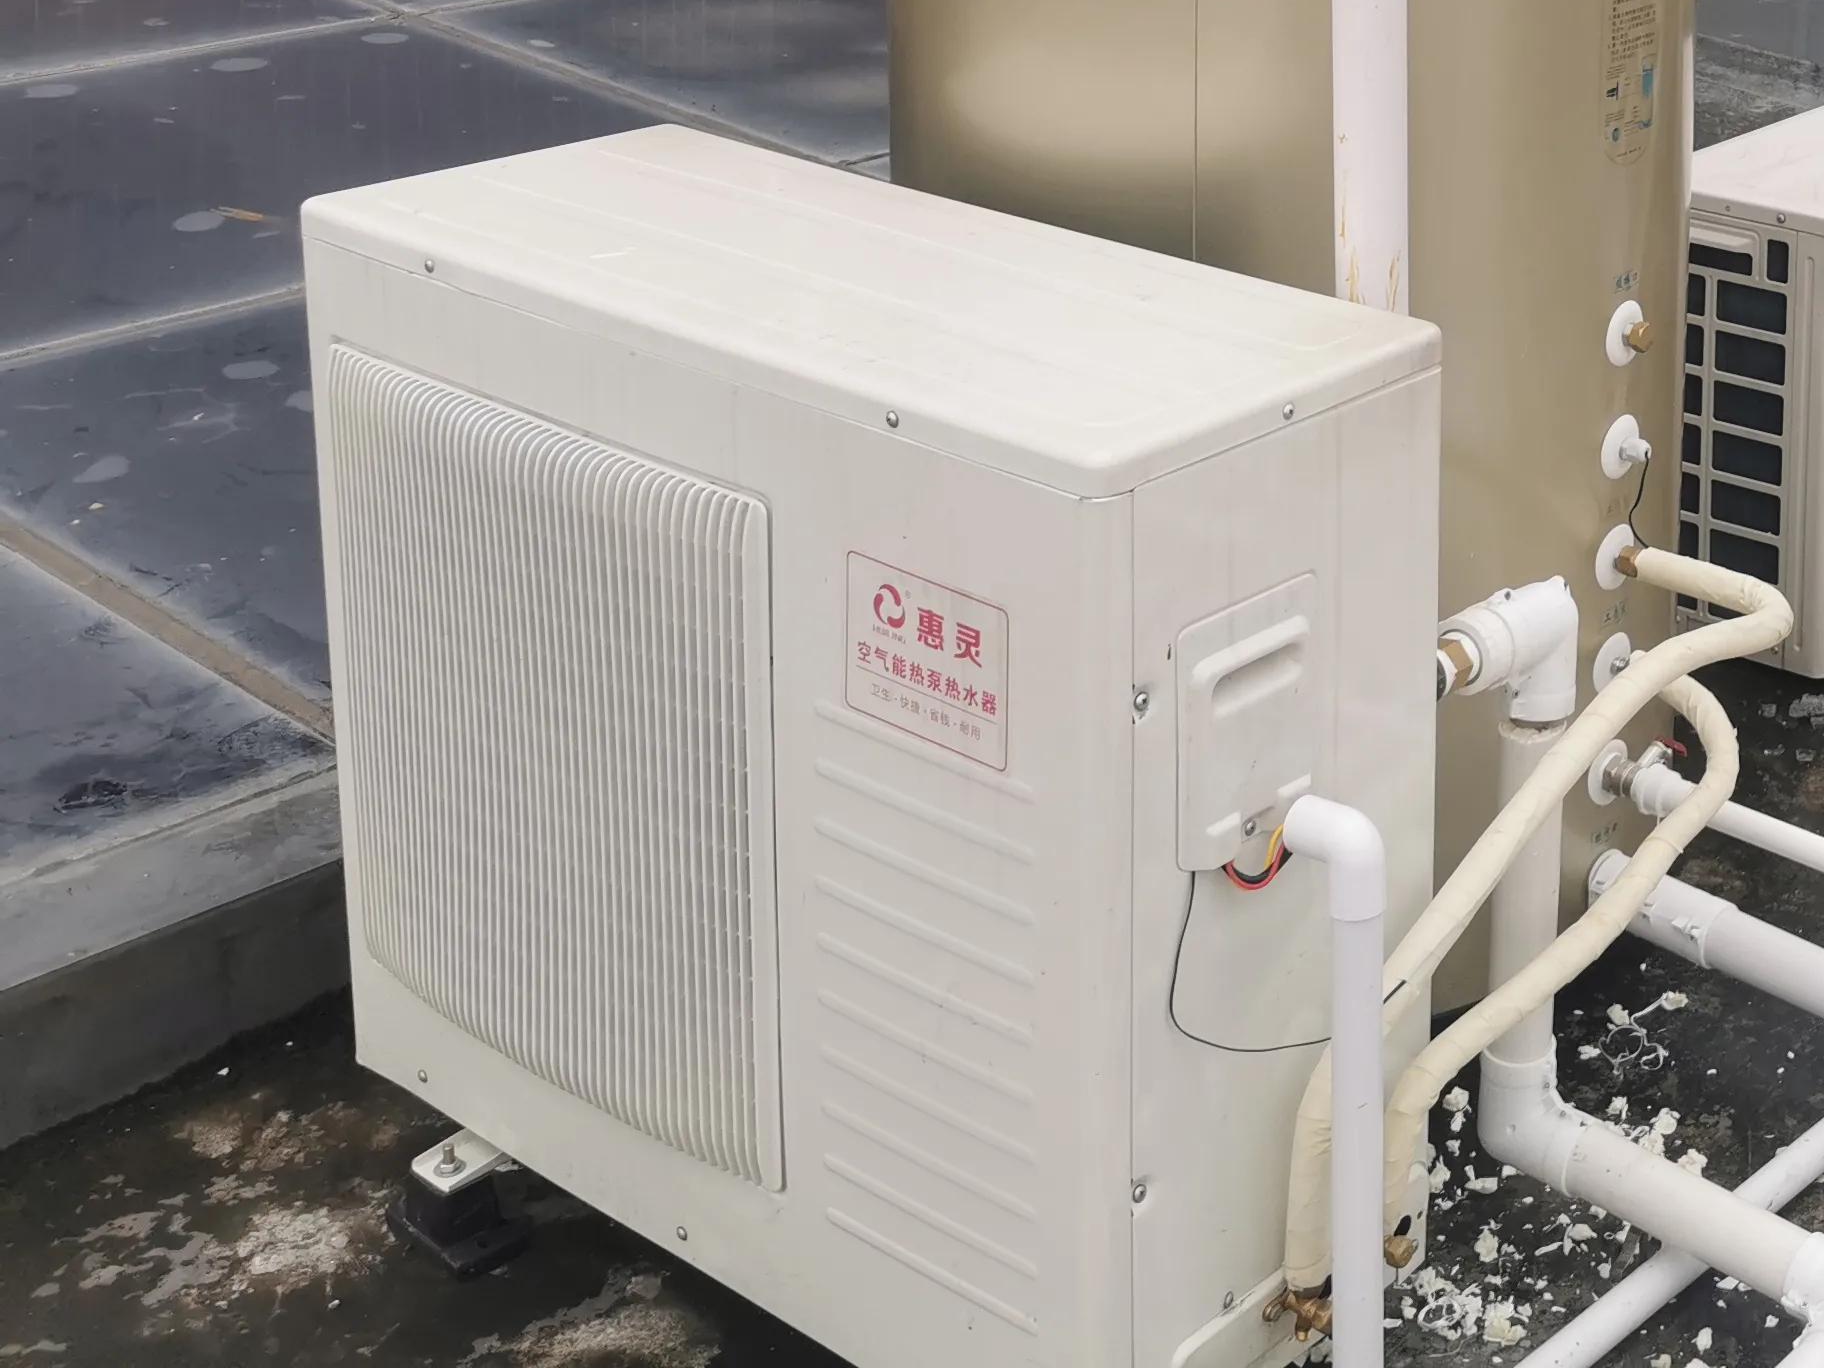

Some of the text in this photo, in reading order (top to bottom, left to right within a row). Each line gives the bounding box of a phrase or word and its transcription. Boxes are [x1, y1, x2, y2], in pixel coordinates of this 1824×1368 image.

[917, 607, 982, 668] 惠灵
[857, 640, 997, 716] 空气能热泵热水器
